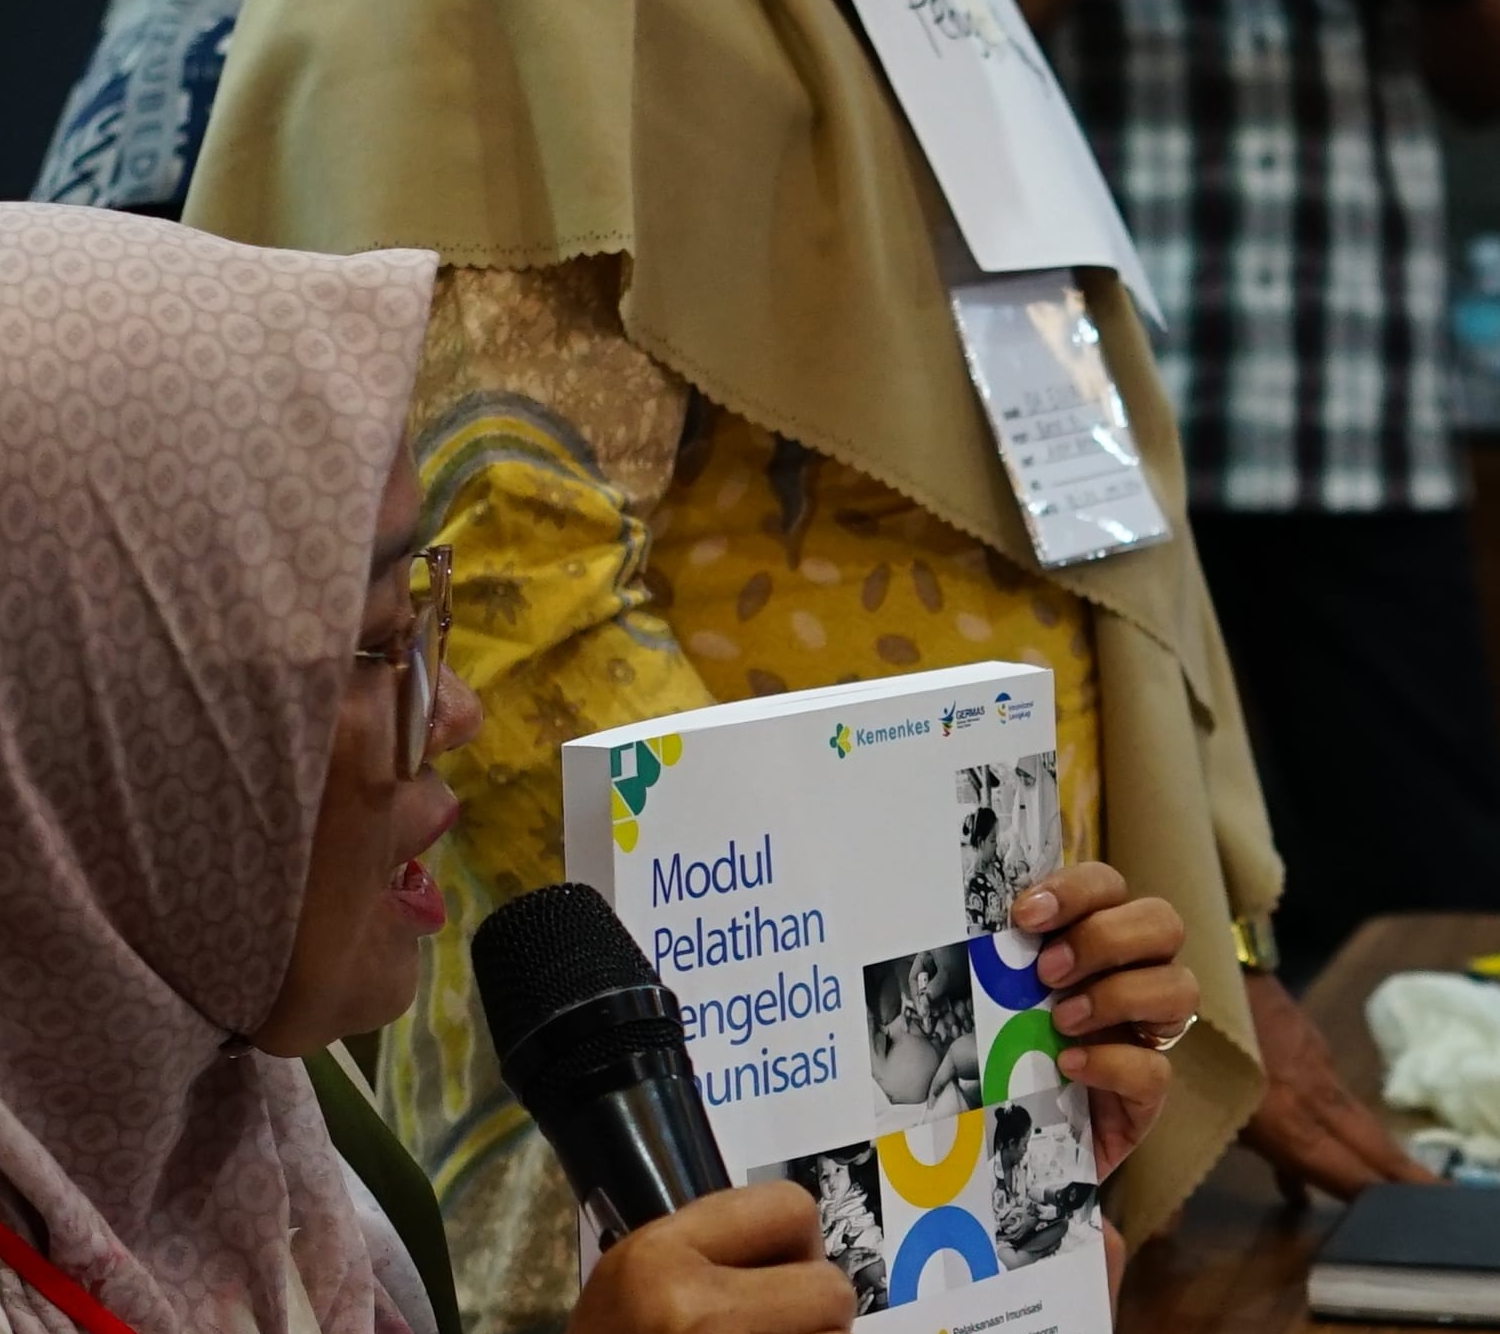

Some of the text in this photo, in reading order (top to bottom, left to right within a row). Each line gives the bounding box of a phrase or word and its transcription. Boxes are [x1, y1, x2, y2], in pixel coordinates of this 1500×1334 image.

[856, 718, 931, 747] Kemenkes
[955, 706, 985, 719] GERMAS
[652, 833, 773, 908] Modul
[654, 906, 825, 975] Pelatihan
[680, 964, 842, 1045] engelola
[692, 1032, 838, 1106] unisasi
[1006, 1302, 1042, 1321] Imunisasi
